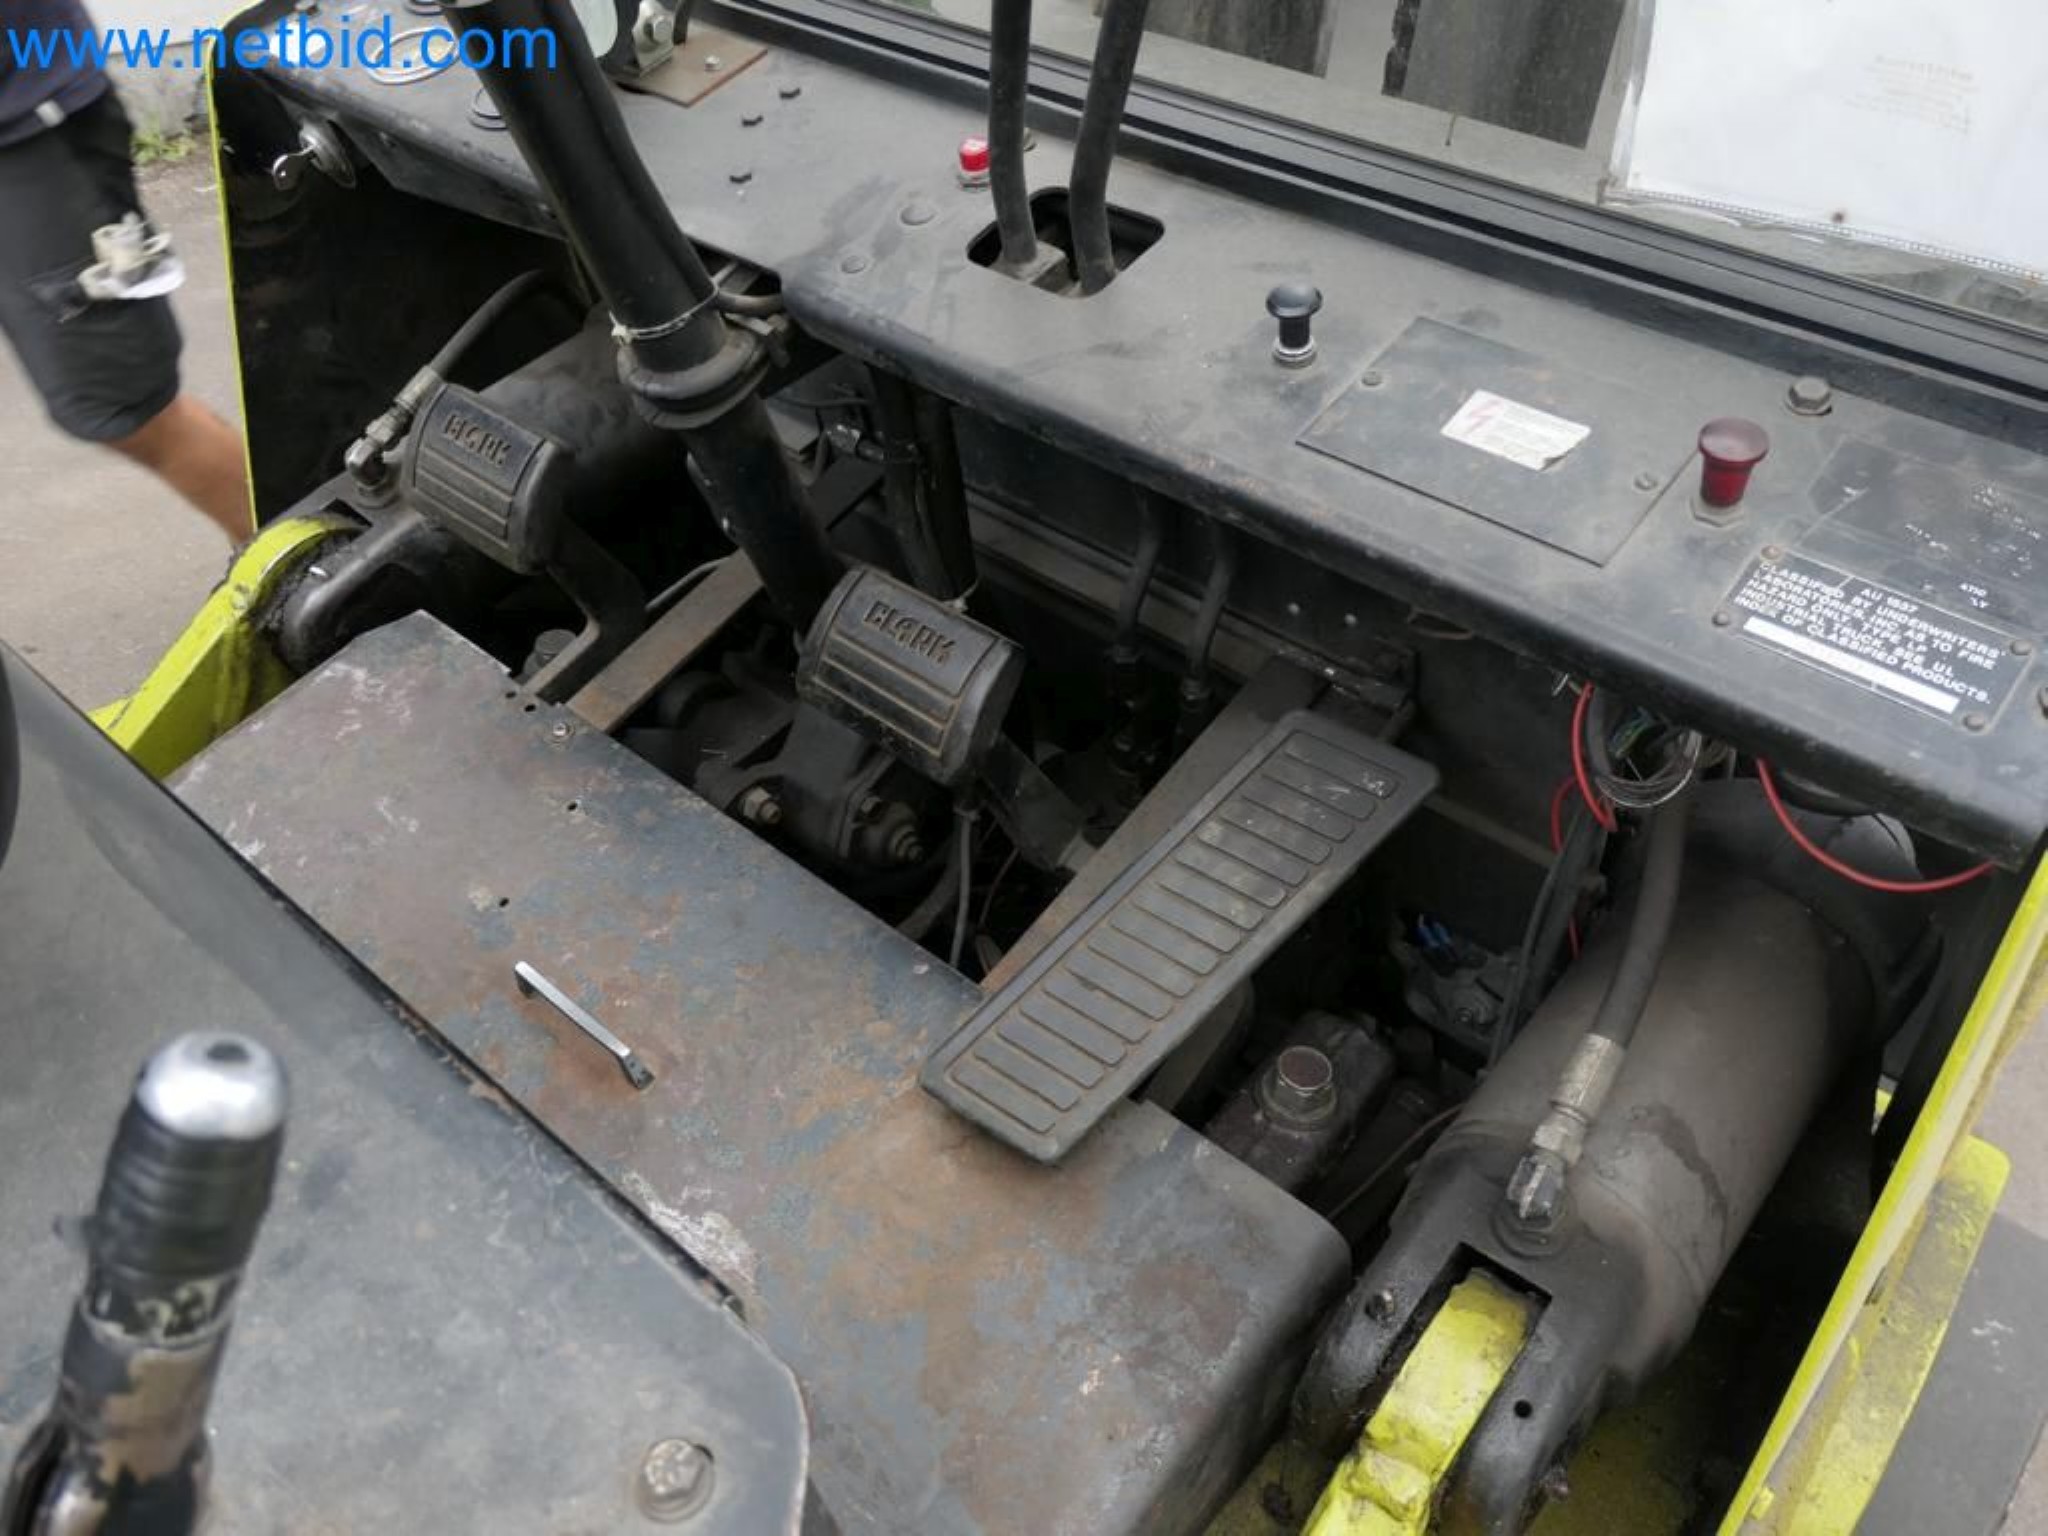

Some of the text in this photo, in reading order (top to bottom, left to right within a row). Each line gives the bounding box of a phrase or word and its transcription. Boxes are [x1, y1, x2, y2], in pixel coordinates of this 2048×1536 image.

[1781, 613, 1805, 627] OF
[1903, 628, 1927, 642] AS
[1931, 637, 1953, 653] TO
[1957, 648, 1996, 670] FIRE
